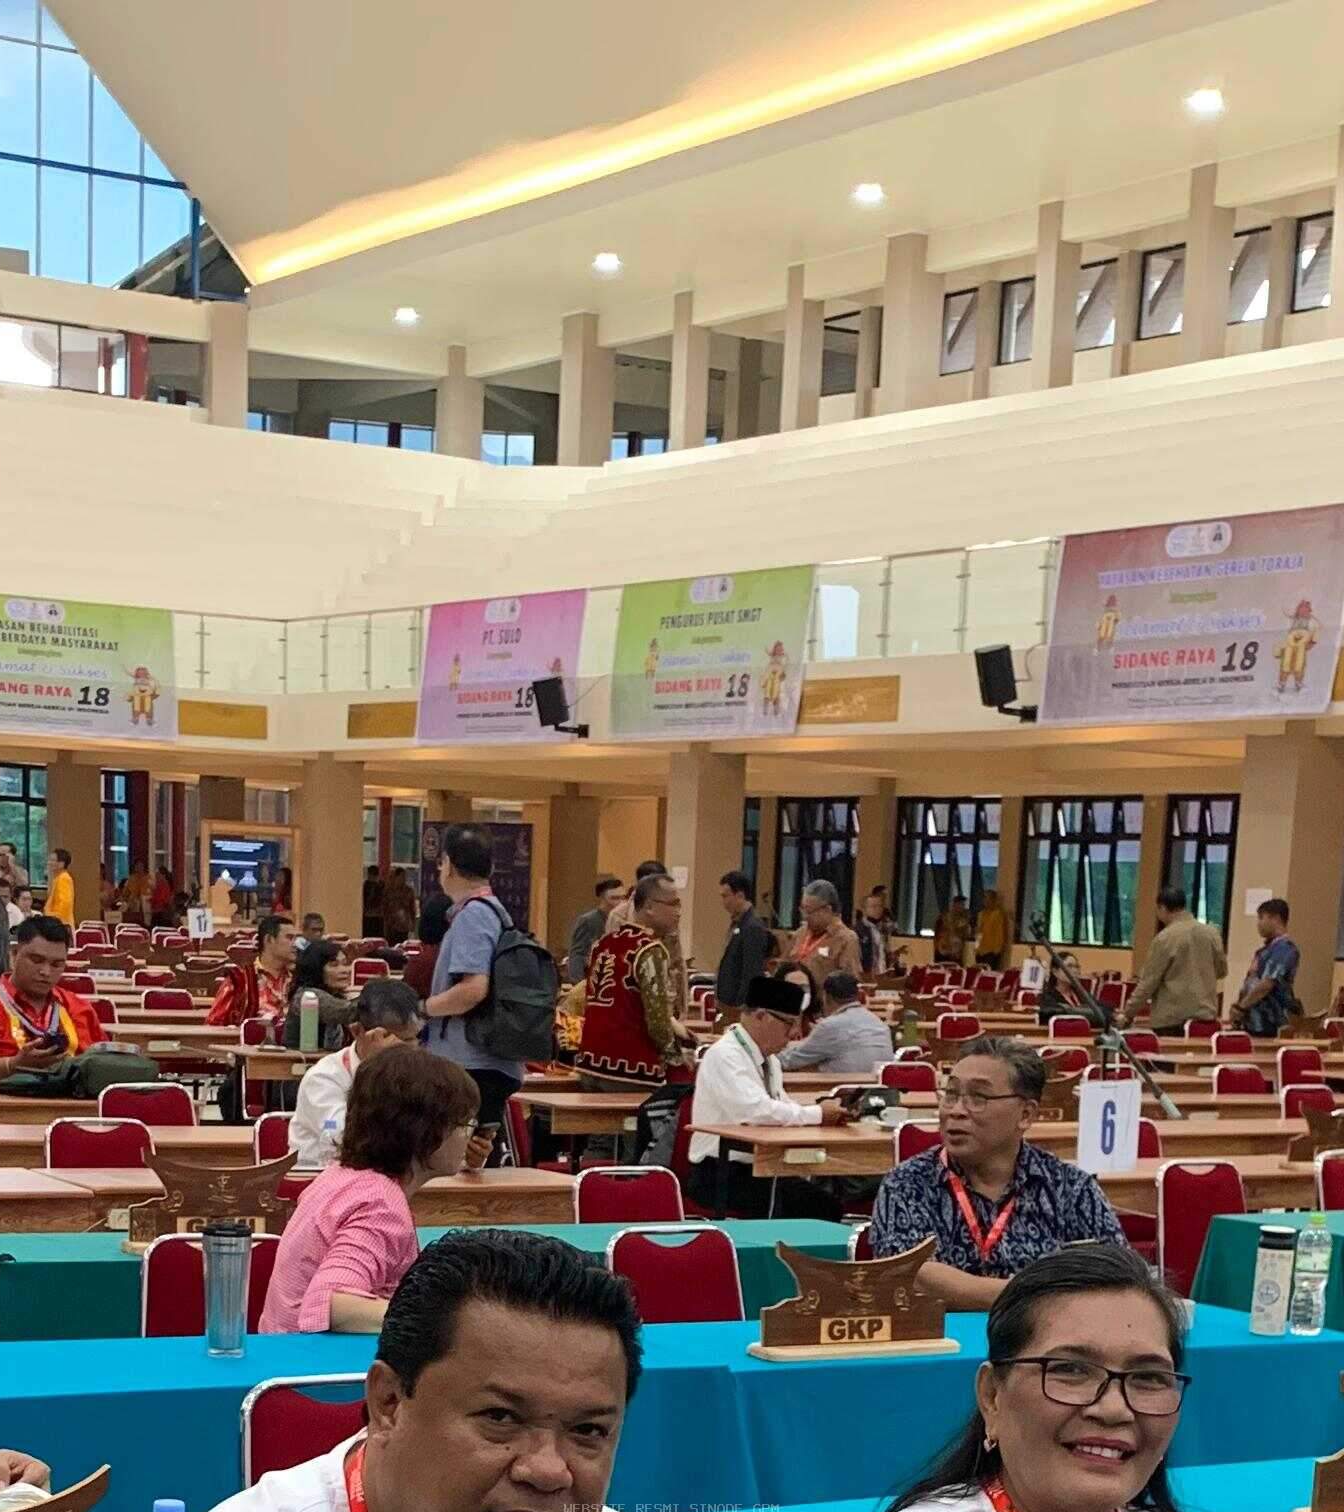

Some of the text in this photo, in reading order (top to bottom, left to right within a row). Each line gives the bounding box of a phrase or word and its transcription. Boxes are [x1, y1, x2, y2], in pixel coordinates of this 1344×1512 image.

[50, 635, 120, 652] MASYARAKAT
[1113, 641, 1260, 673] SIDANG RAYA 18
[34, 683, 73, 699] RAYA
[76, 685, 112, 707] 18
[725, 673, 751, 698] 18
[1100, 1100, 1116, 1155] 6
[827, 1318, 883, 1341] GKP
